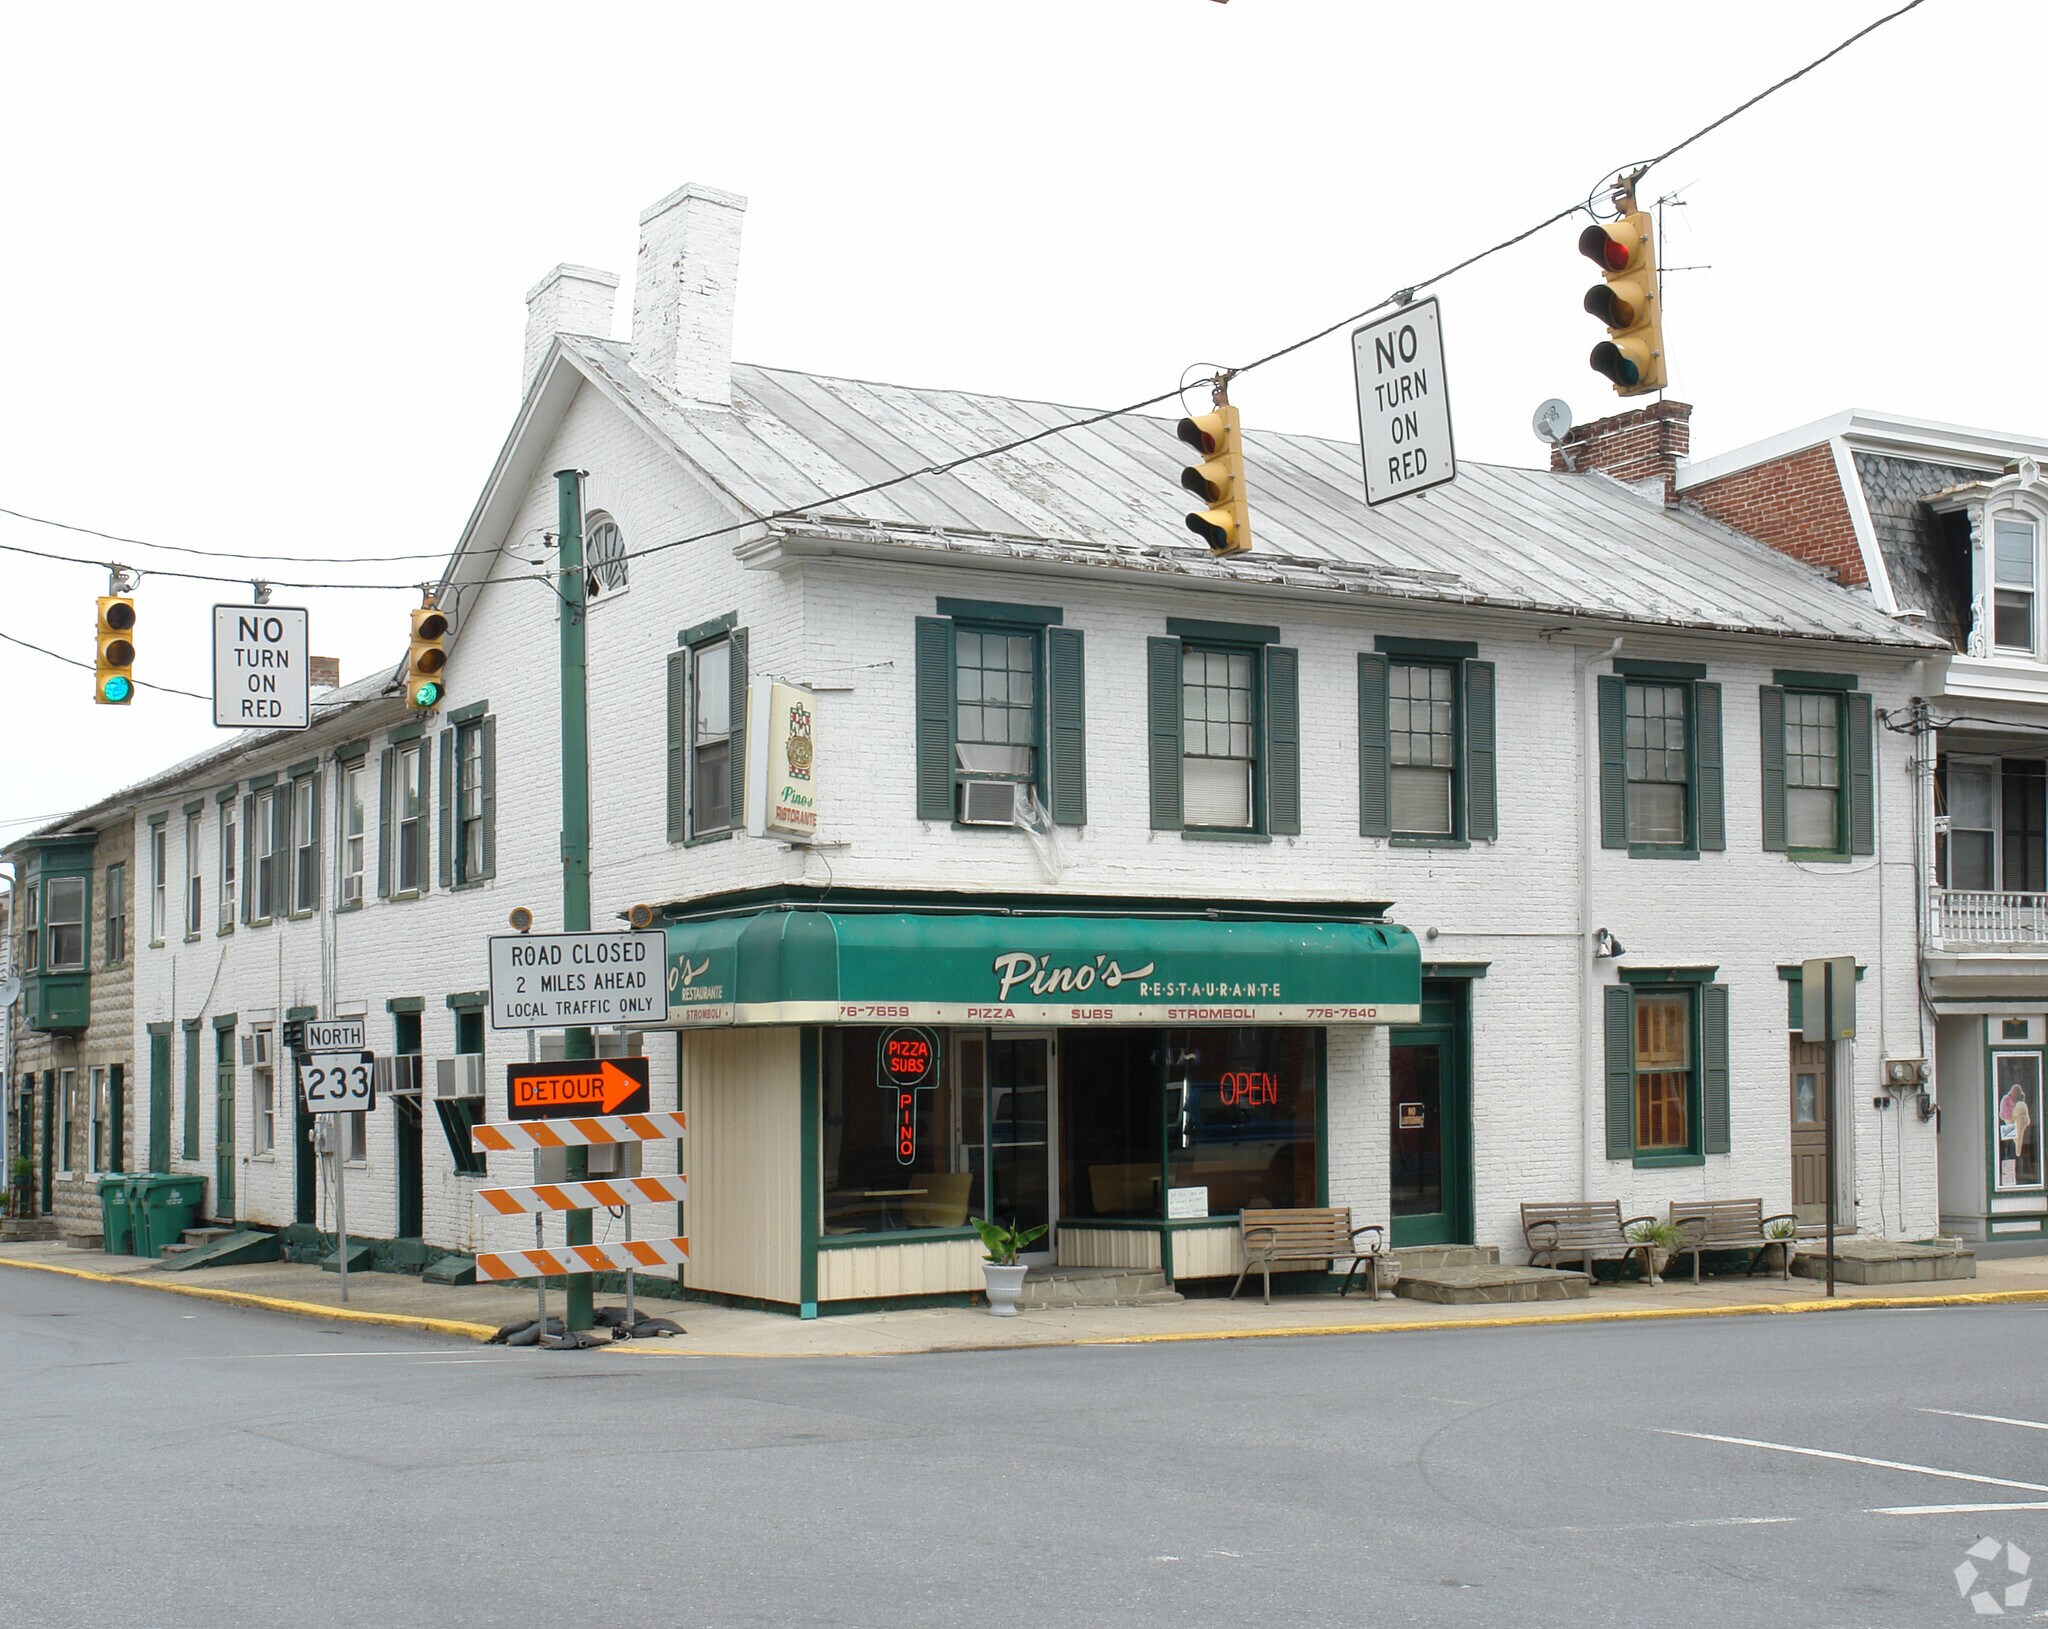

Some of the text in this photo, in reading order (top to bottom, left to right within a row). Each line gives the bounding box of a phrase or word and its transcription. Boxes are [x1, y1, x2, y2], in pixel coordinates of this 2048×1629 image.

[1375, 324, 1417, 374] NO
[1375, 368, 1428, 412] TURN
[1391, 411, 1418, 444] ON
[1388, 448, 1427, 485] RED
[239, 616, 283, 642] NO
[234, 648, 289, 668] TURN
[248, 674, 275, 693] ON
[242, 699, 281, 718] RED
[776, 805, 817, 827] RISTORANTE
[512, 942, 646, 967] ROAD CLOSED
[516, 972, 646, 993] 2 MILES AHEAD
[993, 952, 1155, 1002] Pino's
[507, 997, 653, 1018] LOCAL TRAFFIC ONLY
[686, 1008, 721, 1019] STROMBOLI
[967, 1008, 1015, 1019] PIZZA
[1071, 1009, 1113, 1019] SUBS
[1168, 1008, 1255, 1019] STROMBOLI
[1306, 1008, 1377, 1018] 776-7640
[310, 1027, 361, 1045] NORTH
[888, 1041, 928, 1057] PIZZA
[890, 1058, 925, 1073] SUBS
[308, 1066, 369, 1100] 233
[521, 1078, 604, 1101] DETOUR
[1220, 1072, 1278, 1105] OPEN
[900, 1094, 913, 1155] PINO
